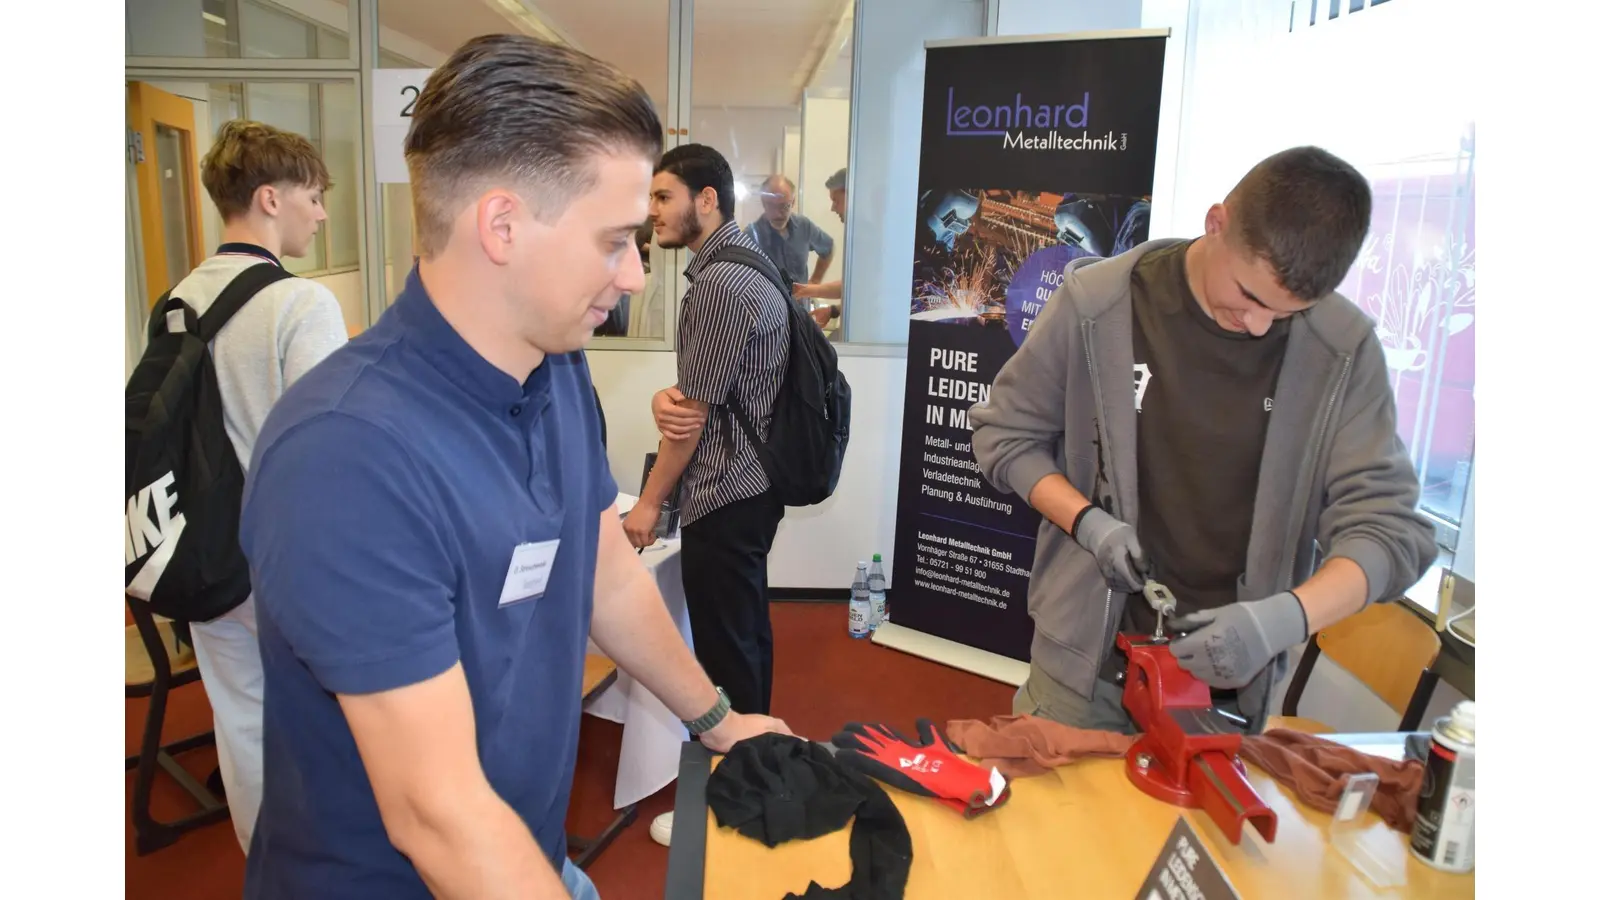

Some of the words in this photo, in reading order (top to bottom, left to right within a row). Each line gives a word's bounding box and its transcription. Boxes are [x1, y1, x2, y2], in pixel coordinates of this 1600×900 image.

[400, 85, 419, 117] 2
[946, 87, 1090, 135] Leonhard
[1003, 131, 1117, 151] Metalltechnik
[1120, 132, 1128, 151] GmbH
[1021, 300, 1042, 316] MIT
[930, 347, 979, 373] PURE
[928, 376, 991, 403] LEIDEN
[926, 404, 944, 426] IN
[925, 435, 953, 449] Metall-
[954, 442, 971, 453] und
[923, 451, 984, 473] Industrieanlag
[922, 467, 982, 489] Verladetechnik
[921, 484, 954, 502] Planung
[955, 491, 963, 502] &
[964, 493, 1012, 515] Ausführung
[918, 531, 948, 545] Leonhard
[948, 538, 991, 556] Metalltechnik
[991, 548, 1012, 561] GmbH
[929, 558, 949, 570] 05721
[955, 564, 964, 573] 99
[964, 567, 973, 576] 51
[974, 569, 987, 580] 900
[948, 550, 969, 562] Straße
[969, 555, 978, 564] 67
[983, 559, 1004, 572] 31655
[915, 566, 1011, 598] info@leonhard-metalltechnik.de
[914, 579, 1008, 610] www.leonhard-metalltechnik.de
